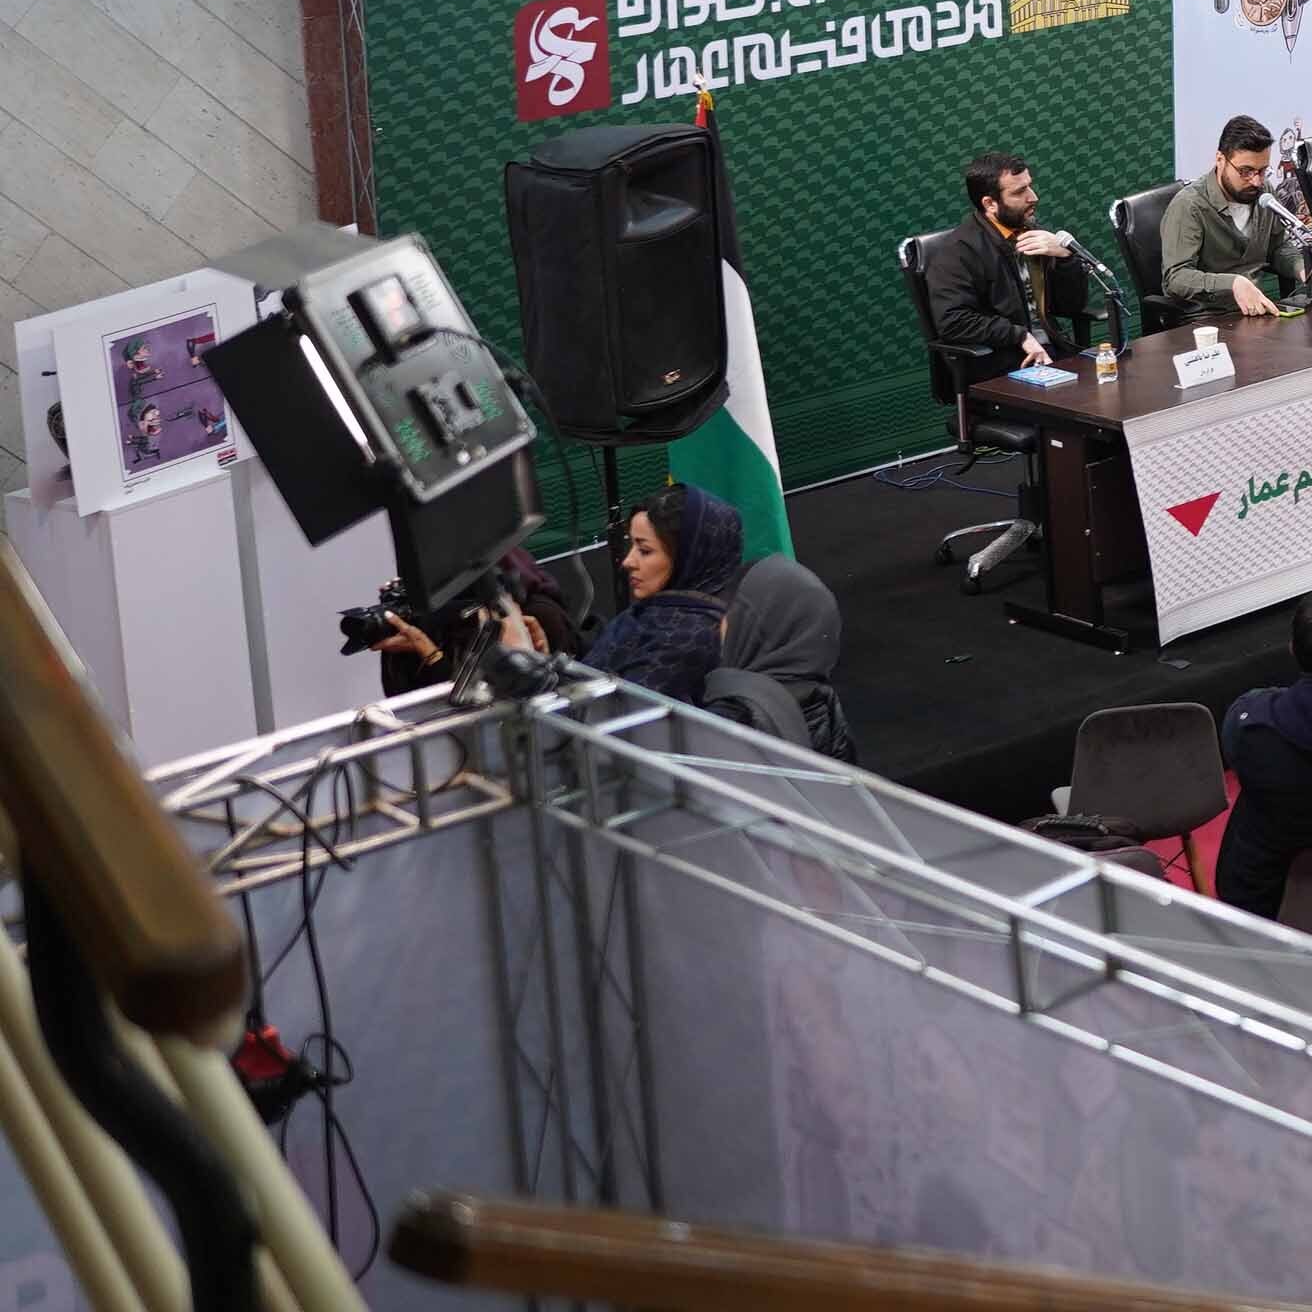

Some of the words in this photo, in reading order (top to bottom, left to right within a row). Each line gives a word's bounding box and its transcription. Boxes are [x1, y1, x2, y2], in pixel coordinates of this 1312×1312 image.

[620, 35, 730, 106] عمار
[734, 14, 868, 84] فیلم
[1237, 469, 1291, 519] عمار
